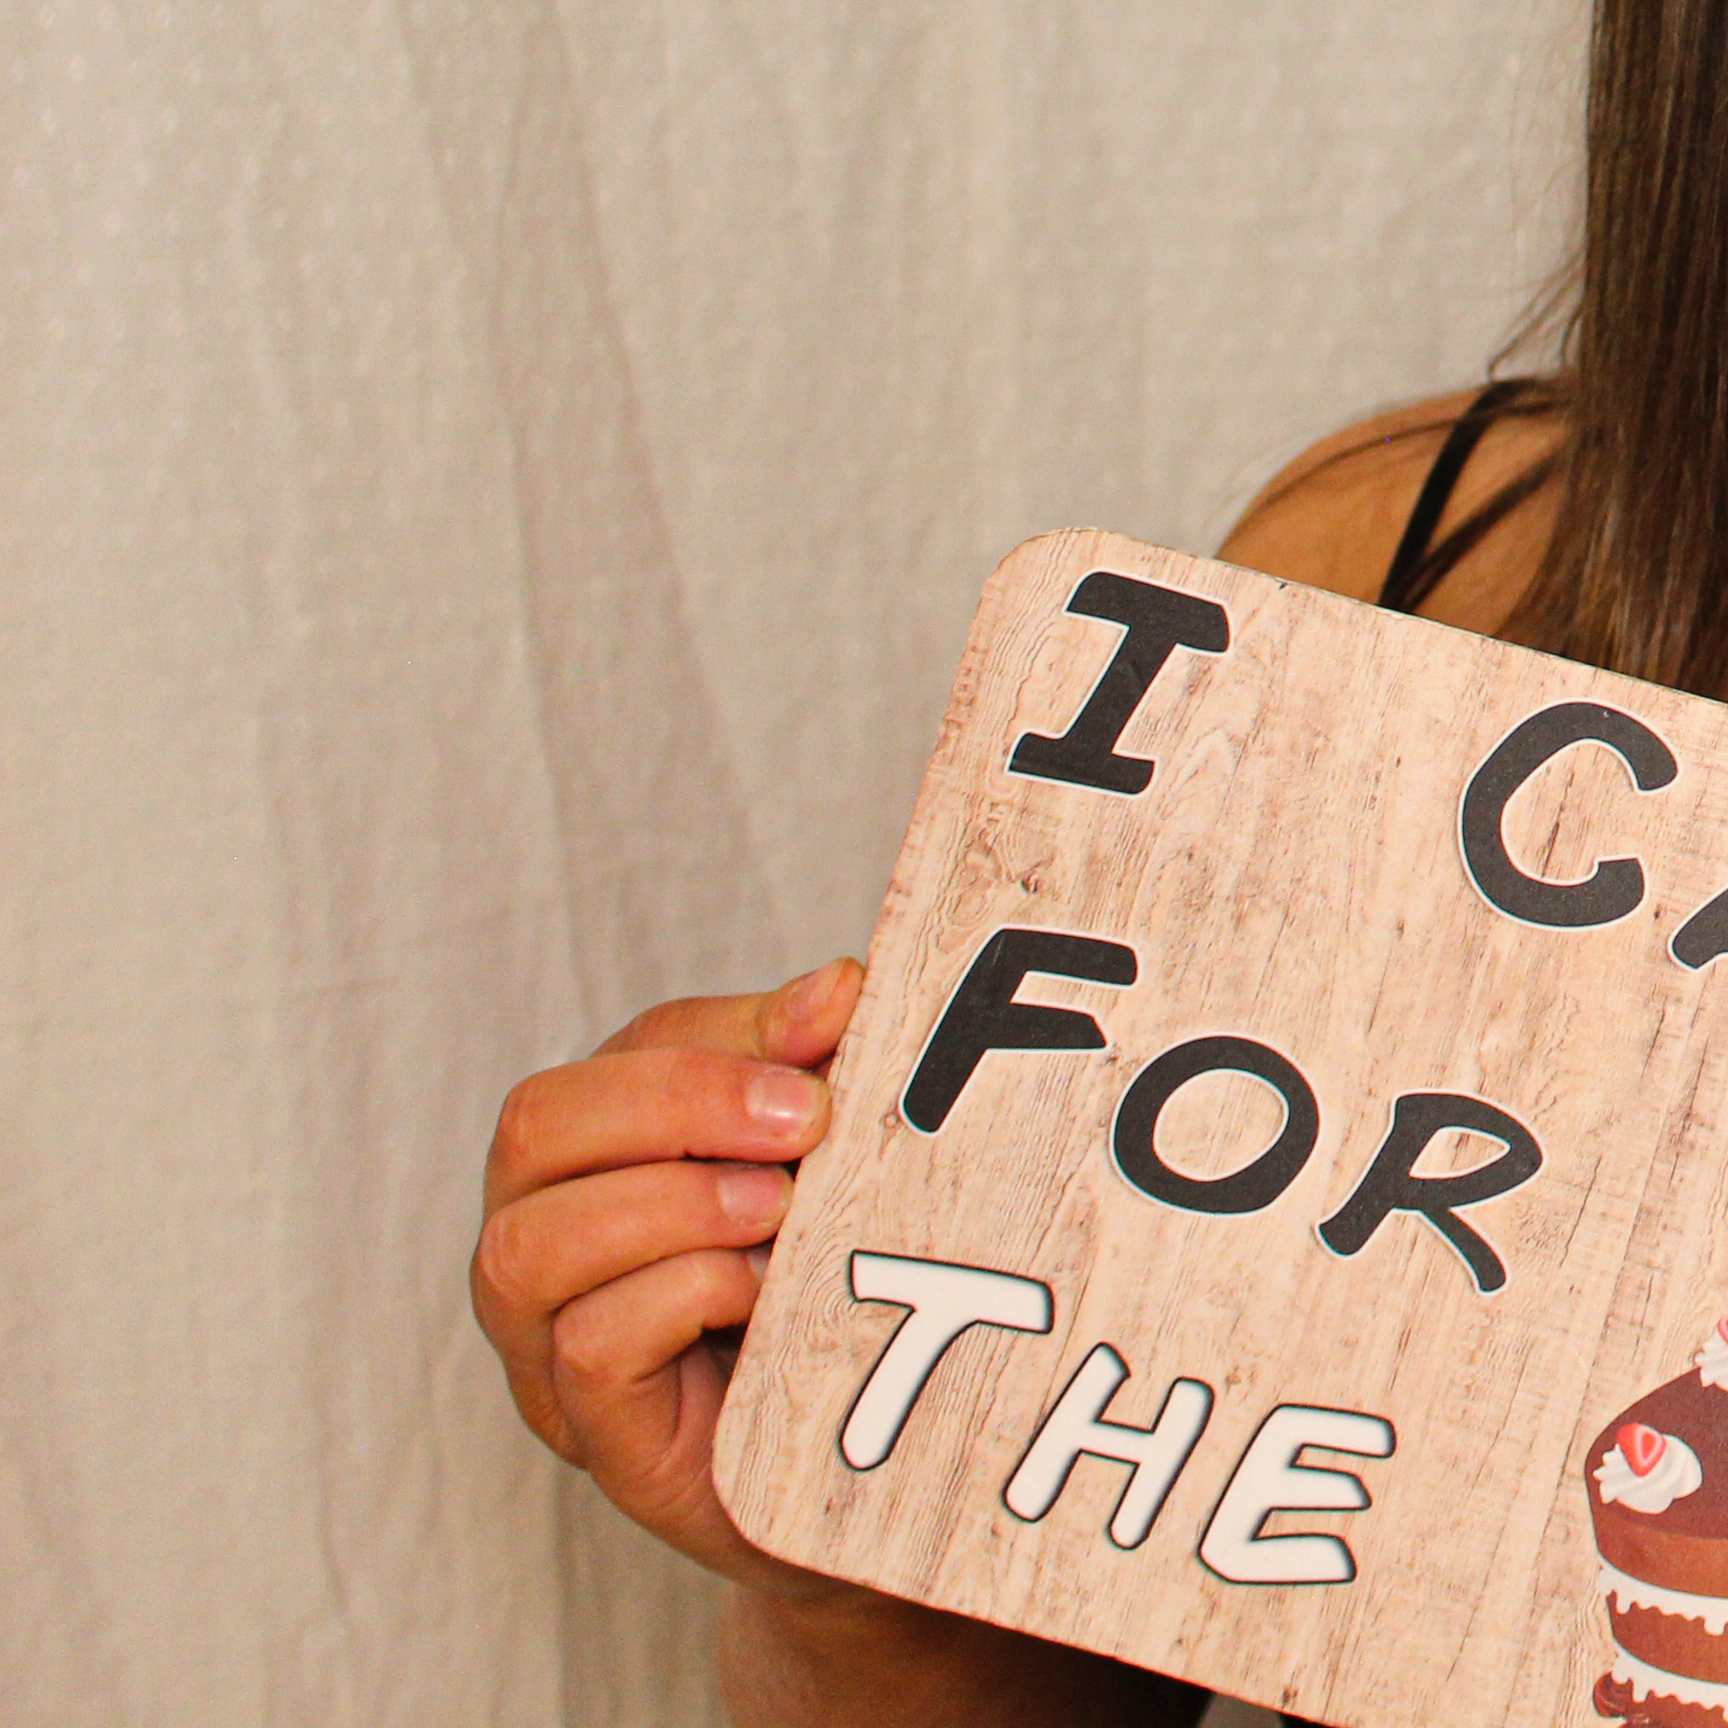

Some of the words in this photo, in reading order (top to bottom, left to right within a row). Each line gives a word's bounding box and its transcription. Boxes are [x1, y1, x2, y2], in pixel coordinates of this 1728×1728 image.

[1007, 570, 1231, 795] I
[900, 931, 1545, 1293] FOR
[841, 1252, 1396, 1586] THE
